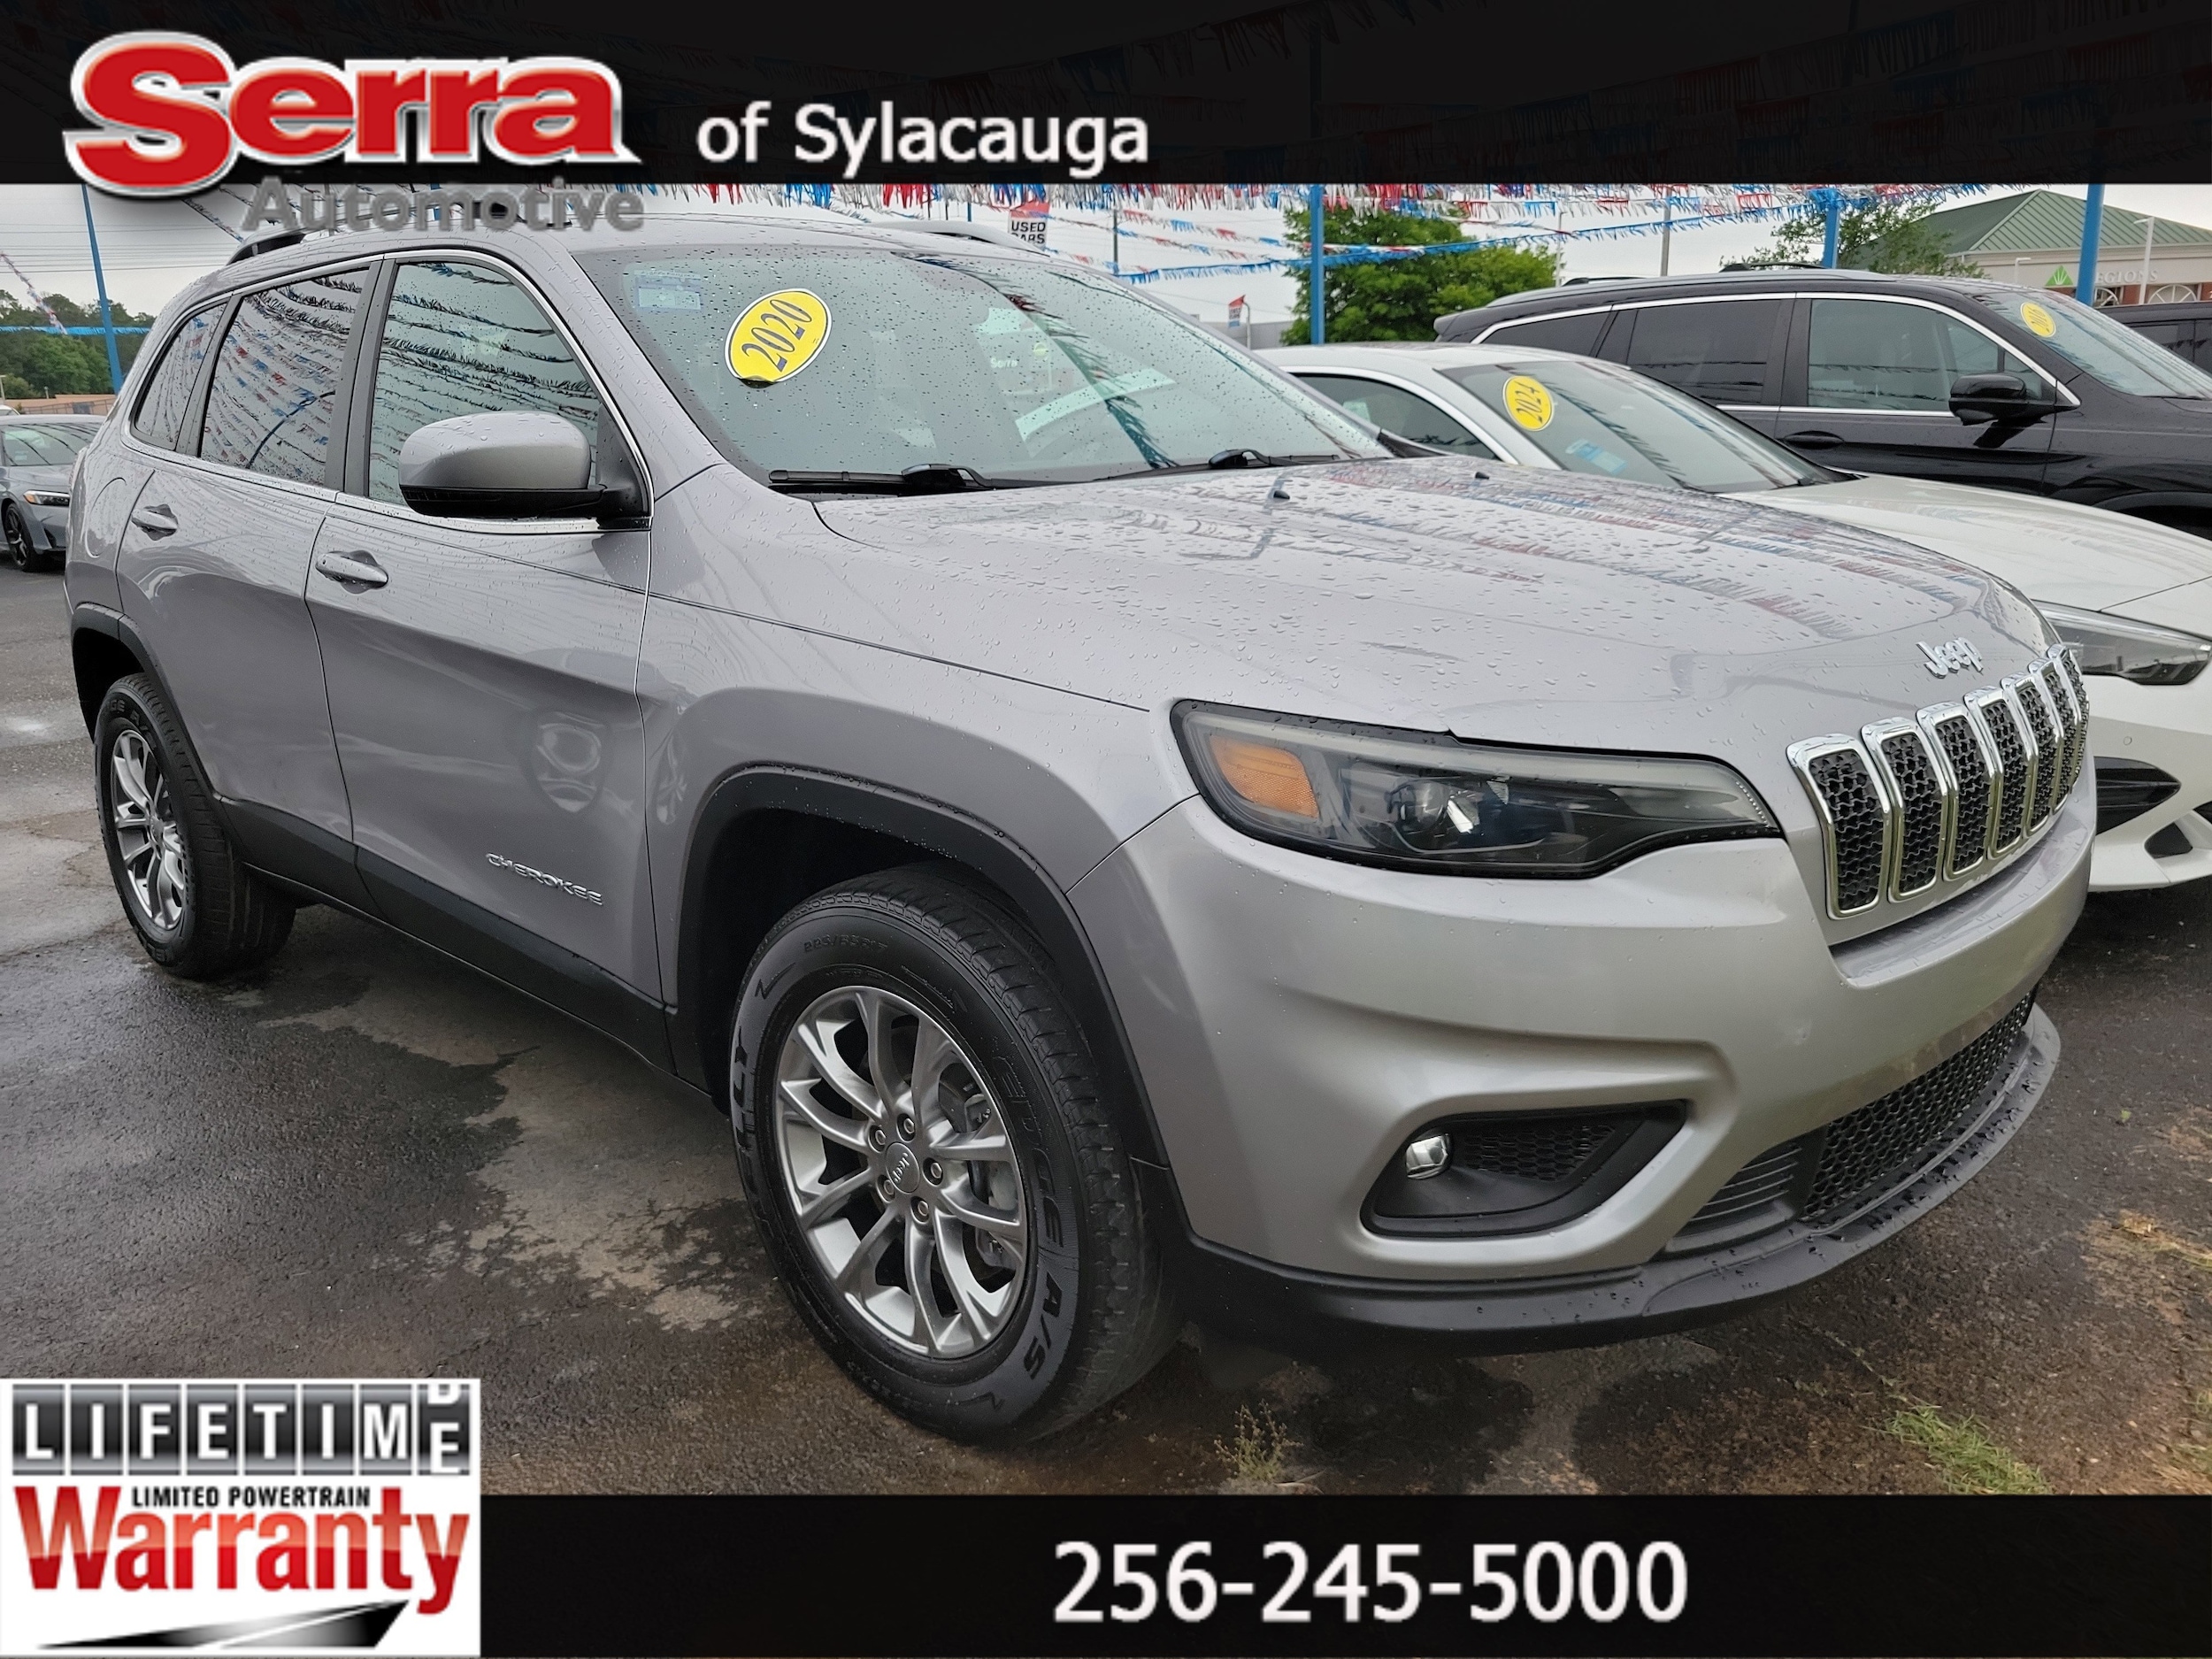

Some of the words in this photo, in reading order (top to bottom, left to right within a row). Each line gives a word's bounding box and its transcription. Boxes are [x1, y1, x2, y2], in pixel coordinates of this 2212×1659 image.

[1010, 219, 1047, 233] USED
[741, 299, 812, 373] 2020
[1916, 637, 1983, 679] Jeep
[486, 852, 603, 905] CHEROKEE
[1024, 1271, 1063, 1379] A/S
